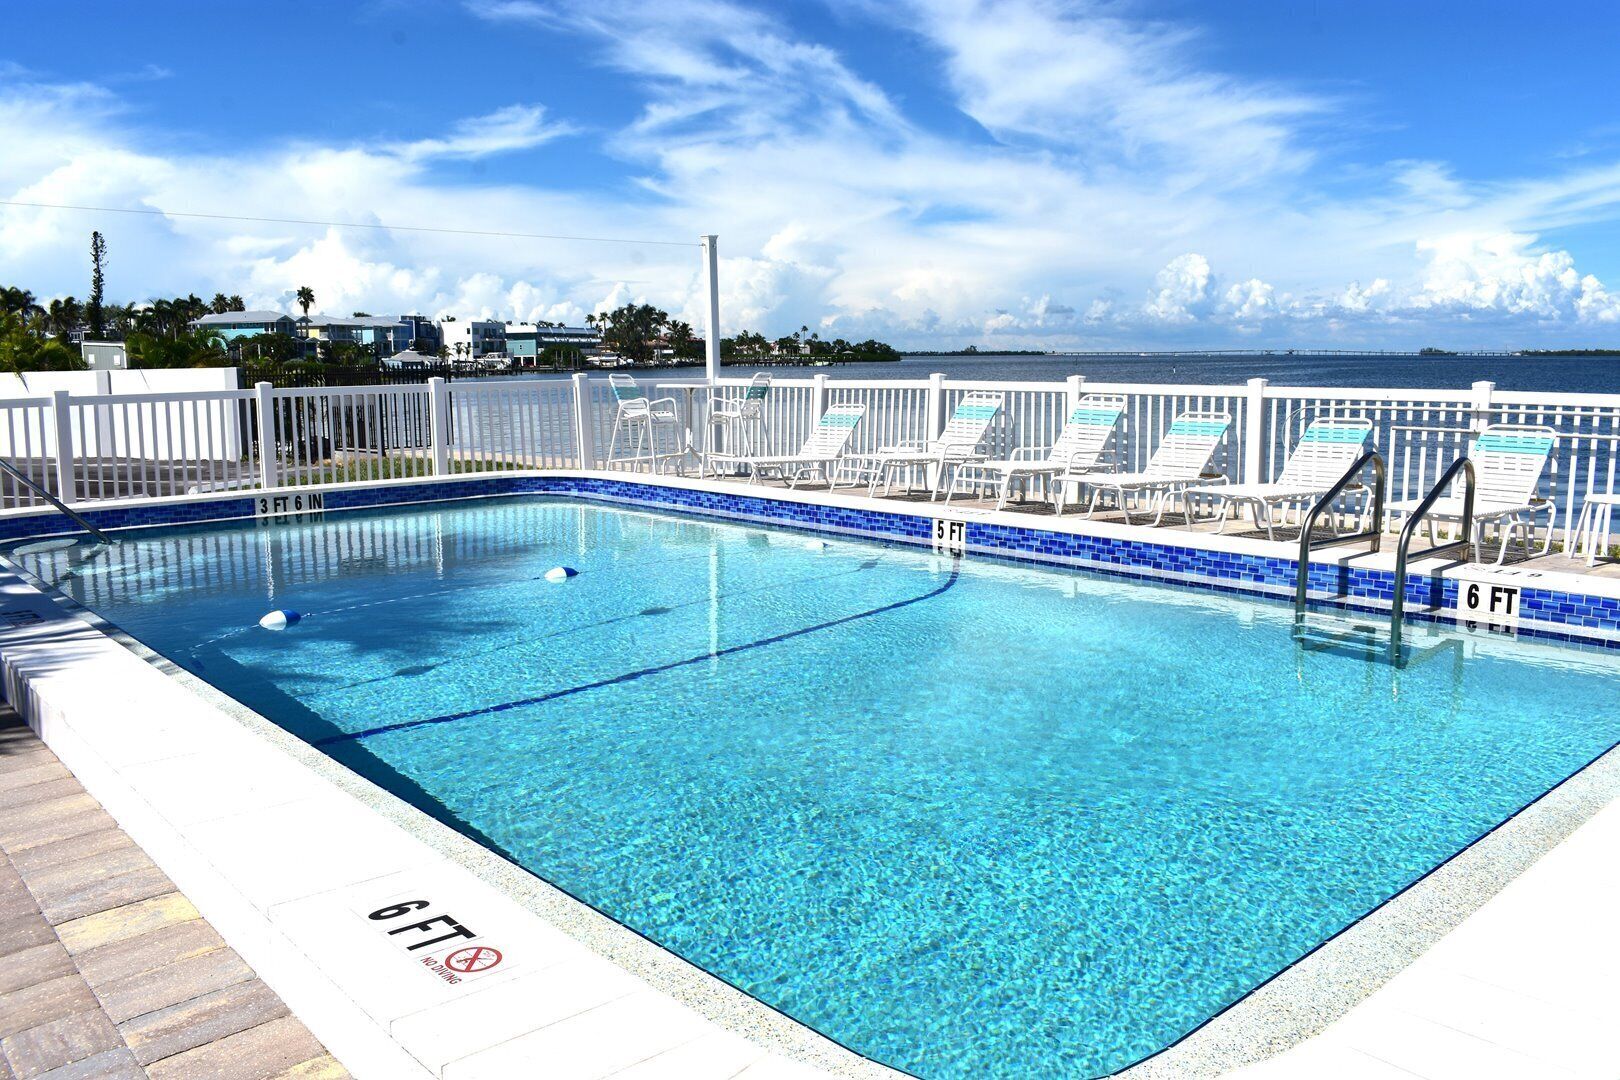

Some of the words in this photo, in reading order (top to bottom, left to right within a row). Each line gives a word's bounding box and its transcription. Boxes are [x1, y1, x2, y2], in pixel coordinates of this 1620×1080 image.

[260, 498, 268, 514] 3
[273, 496, 289, 513] FT
[294, 495, 303, 511] 6
[308, 493, 322, 510] IN
[937, 520, 944, 540] 5
[949, 521, 965, 542] FT
[1467, 583, 1480, 610] 6
[1489, 586, 1518, 615] FT
[368, 899, 431, 921] 6
[386, 914, 477, 952] FT
[420, 956, 437, 967] NO
[431, 963, 463, 985] DIVING
